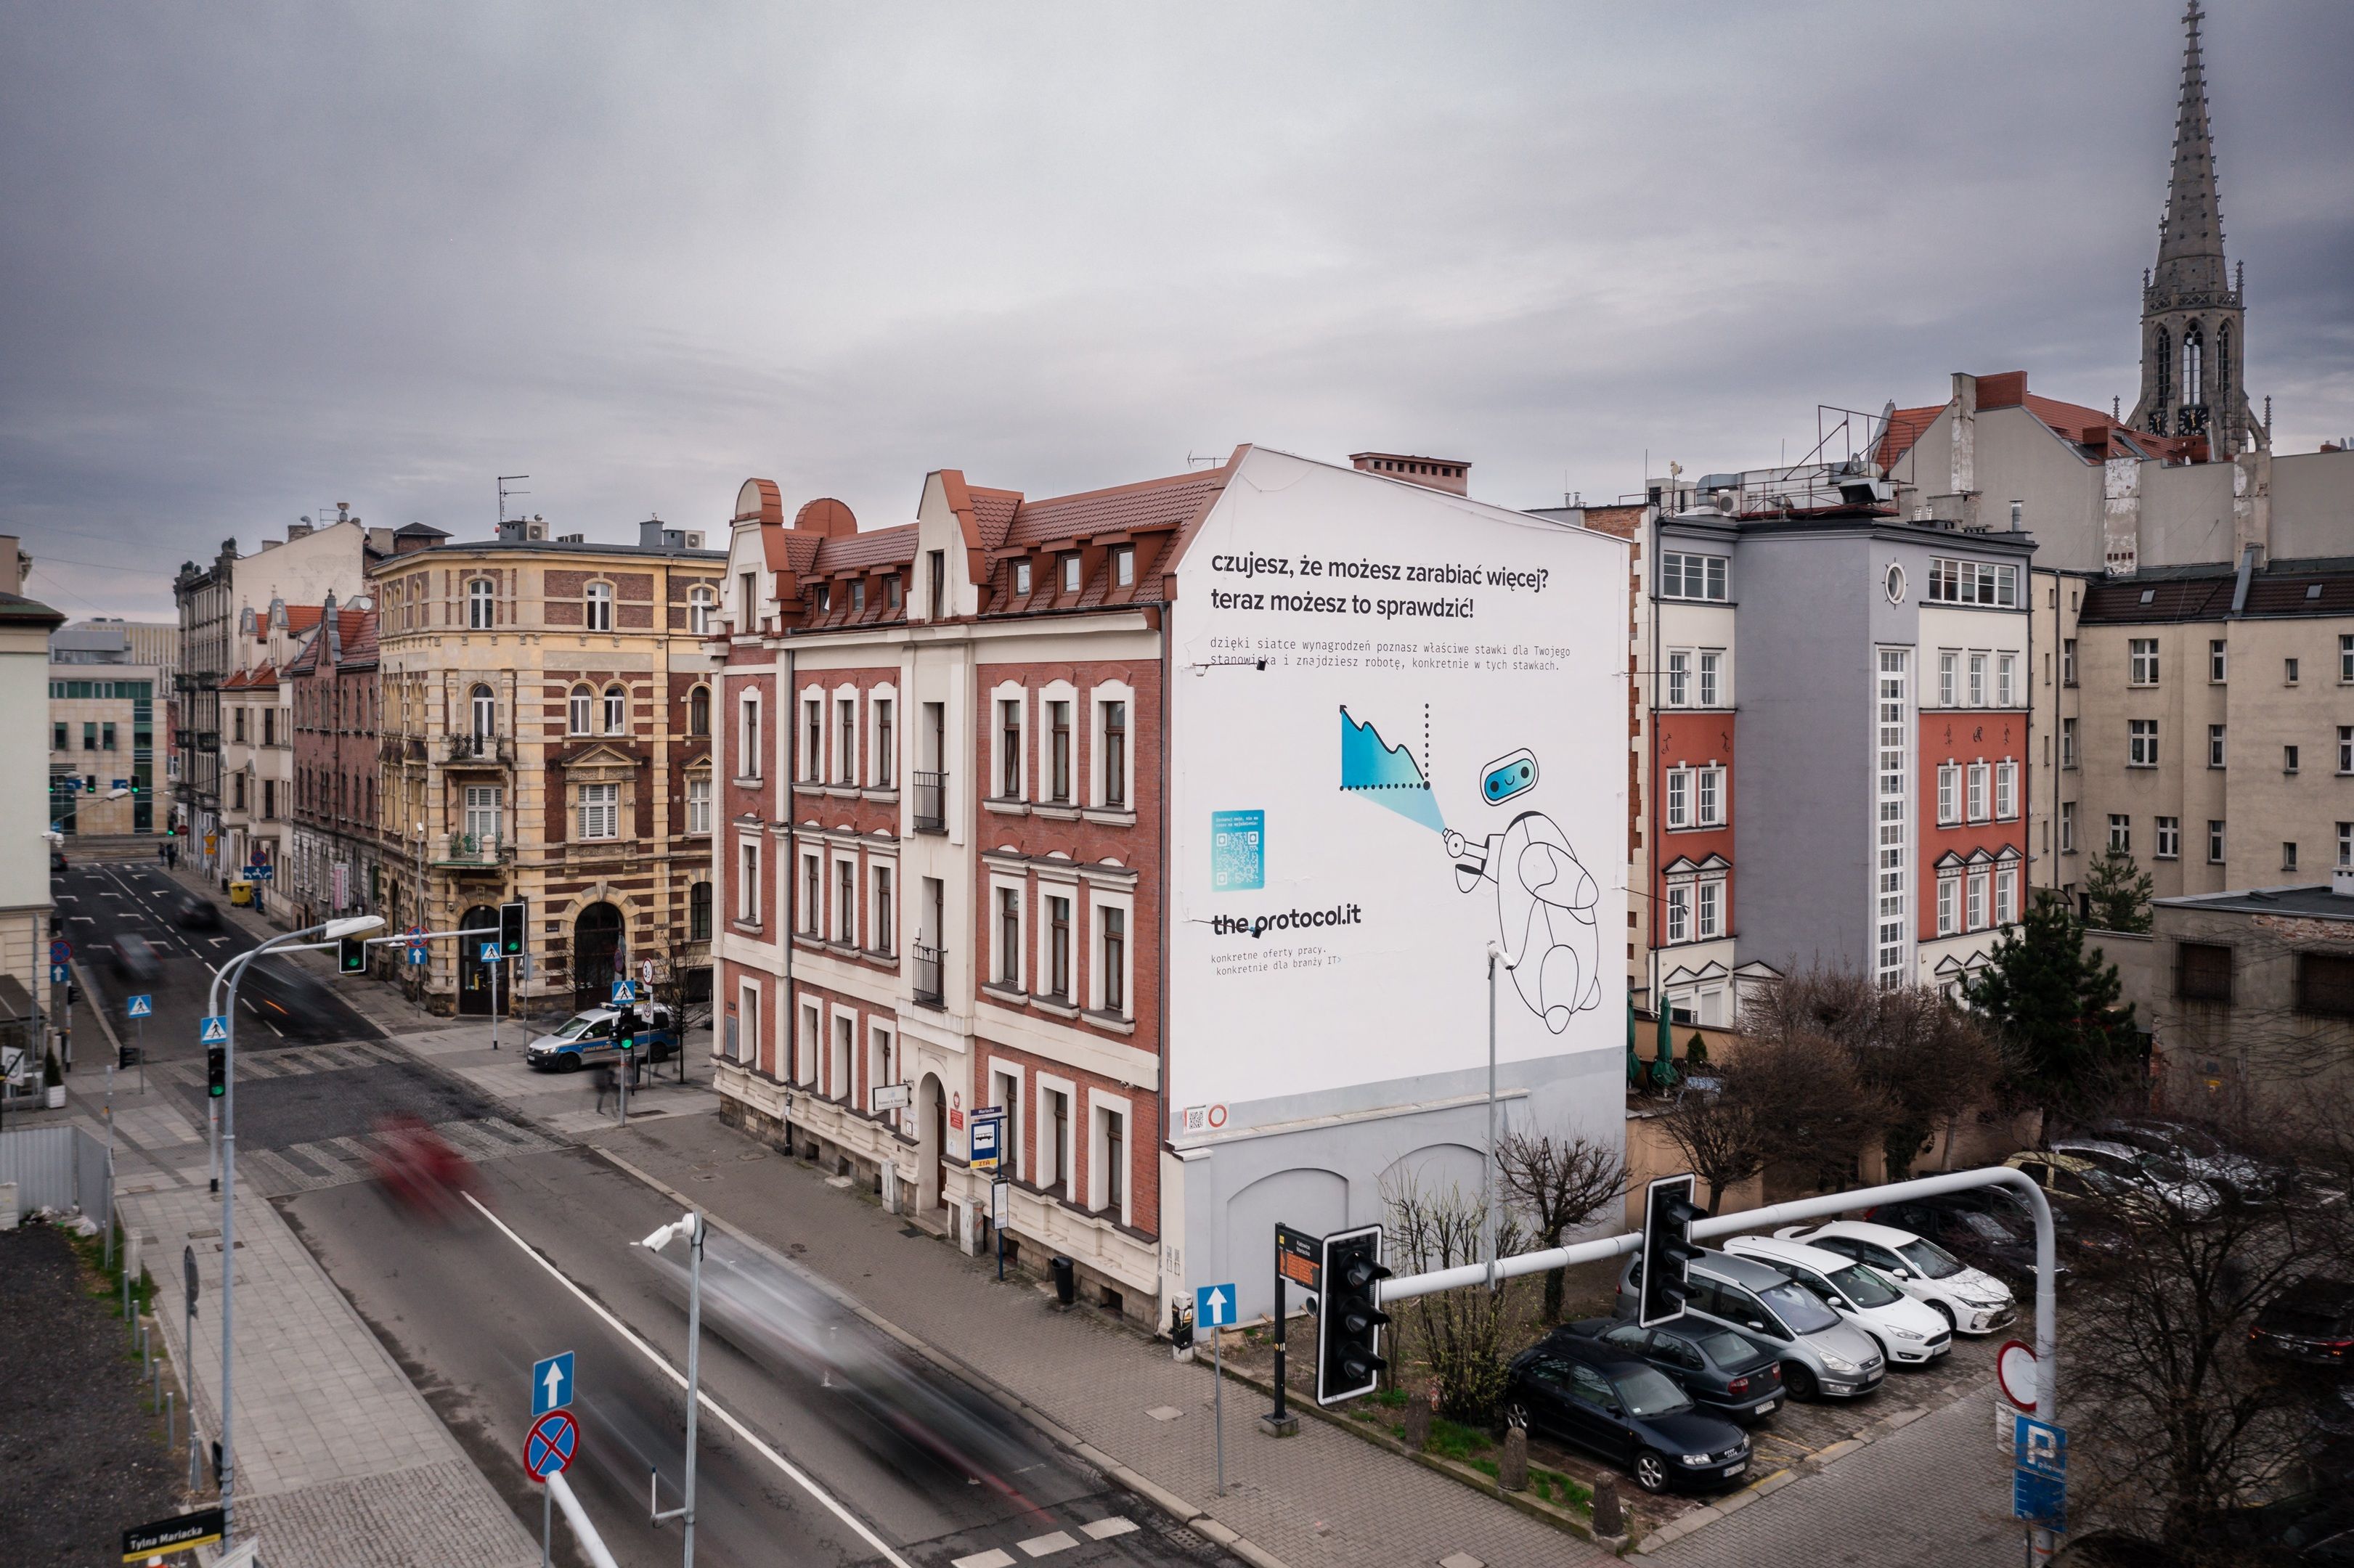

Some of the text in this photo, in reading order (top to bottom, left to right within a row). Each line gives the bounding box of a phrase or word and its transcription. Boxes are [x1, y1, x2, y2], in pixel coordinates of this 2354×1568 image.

[1211, 550, 1549, 594] czujesz, że możesz zarabiać więcej?
[1210, 588, 1474, 621] teraz możesz to sprawdzić!
[1210, 636, 1571, 659] dzięki siatce wynagrodzeń poznasz właściwe stawki dla Twojego
[1210, 653, 1559, 672] stanowiska i znajdziesz robotę, konkretnie w tych stawkach.
[1210, 946, 1327, 964] konkretne oferty pracy.
[1216, 962, 1268, 976] konkretnie
[1273, 960, 1289, 971] dla
[1292, 957, 1323, 968] branży
[129, 1537, 158, 1551] Tylna
[159, 1526, 203, 1544] Mariacka
